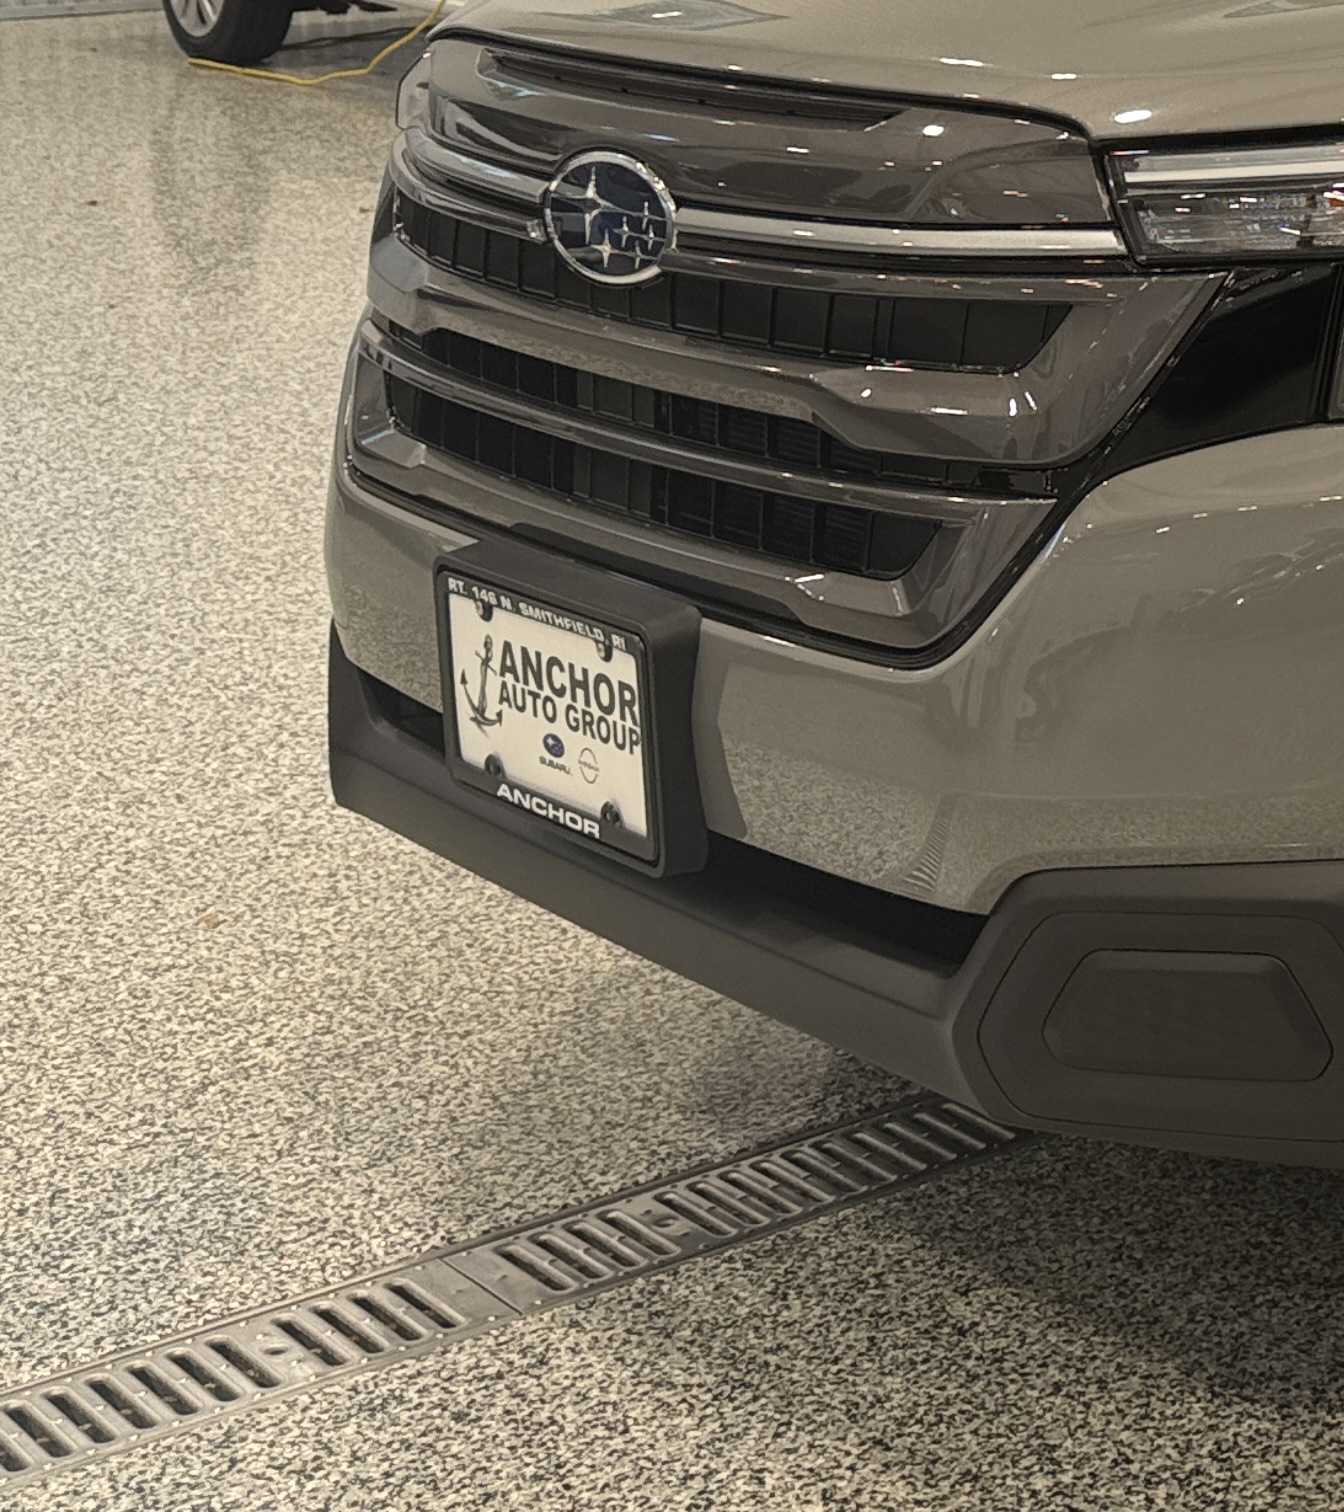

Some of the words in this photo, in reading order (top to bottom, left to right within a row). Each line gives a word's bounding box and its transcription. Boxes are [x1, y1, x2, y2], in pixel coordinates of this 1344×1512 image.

[472, 586, 498, 605] 146
[611, 633, 627, 652] RI
[498, 679, 557, 724] AUTO
[565, 704, 641, 755] GROUP
[499, 640, 640, 727] ANCHOR
[496, 783, 600, 839] ANCHOR
